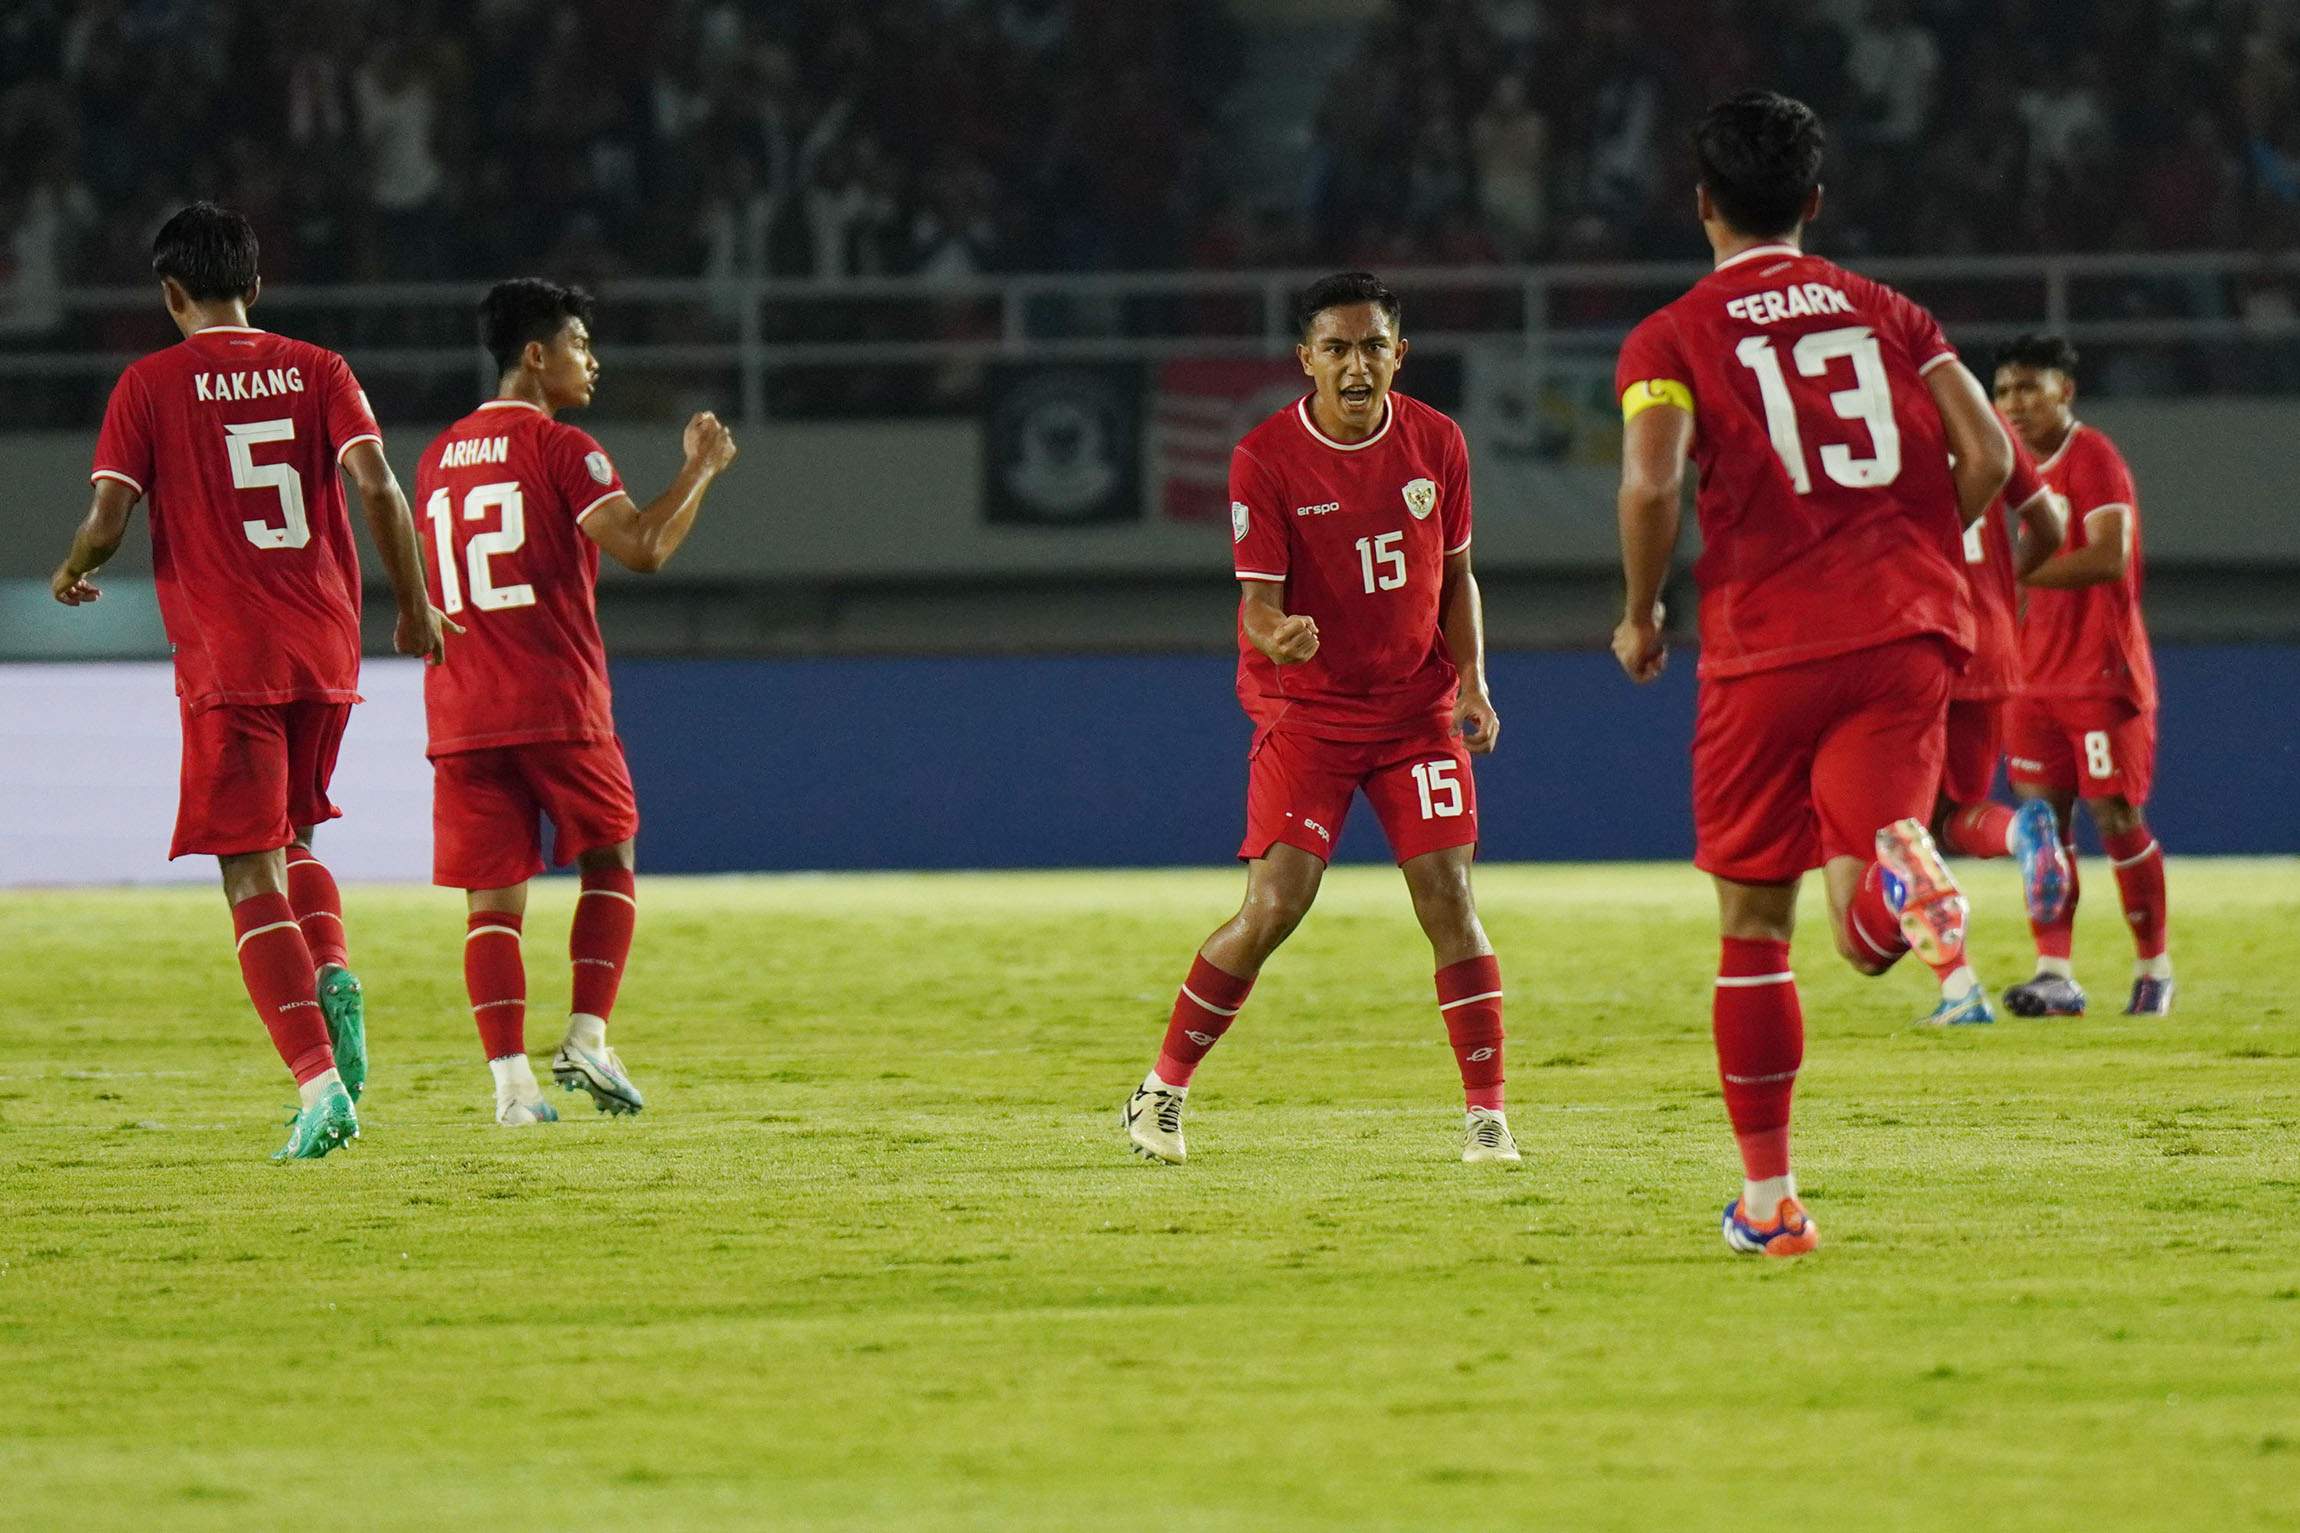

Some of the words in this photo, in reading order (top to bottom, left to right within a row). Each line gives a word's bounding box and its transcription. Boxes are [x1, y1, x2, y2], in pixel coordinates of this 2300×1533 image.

[194, 366, 304, 401] KAKANG
[1735, 326, 1902, 494] 13
[439, 436, 508, 469] ARHAN
[223, 418, 311, 549] 5
[1297, 502, 1340, 516] erspo
[426, 481, 536, 614] 12
[1355, 530, 1407, 594] 15
[2084, 731, 2112, 779] 8
[1411, 760, 1463, 820] 15
